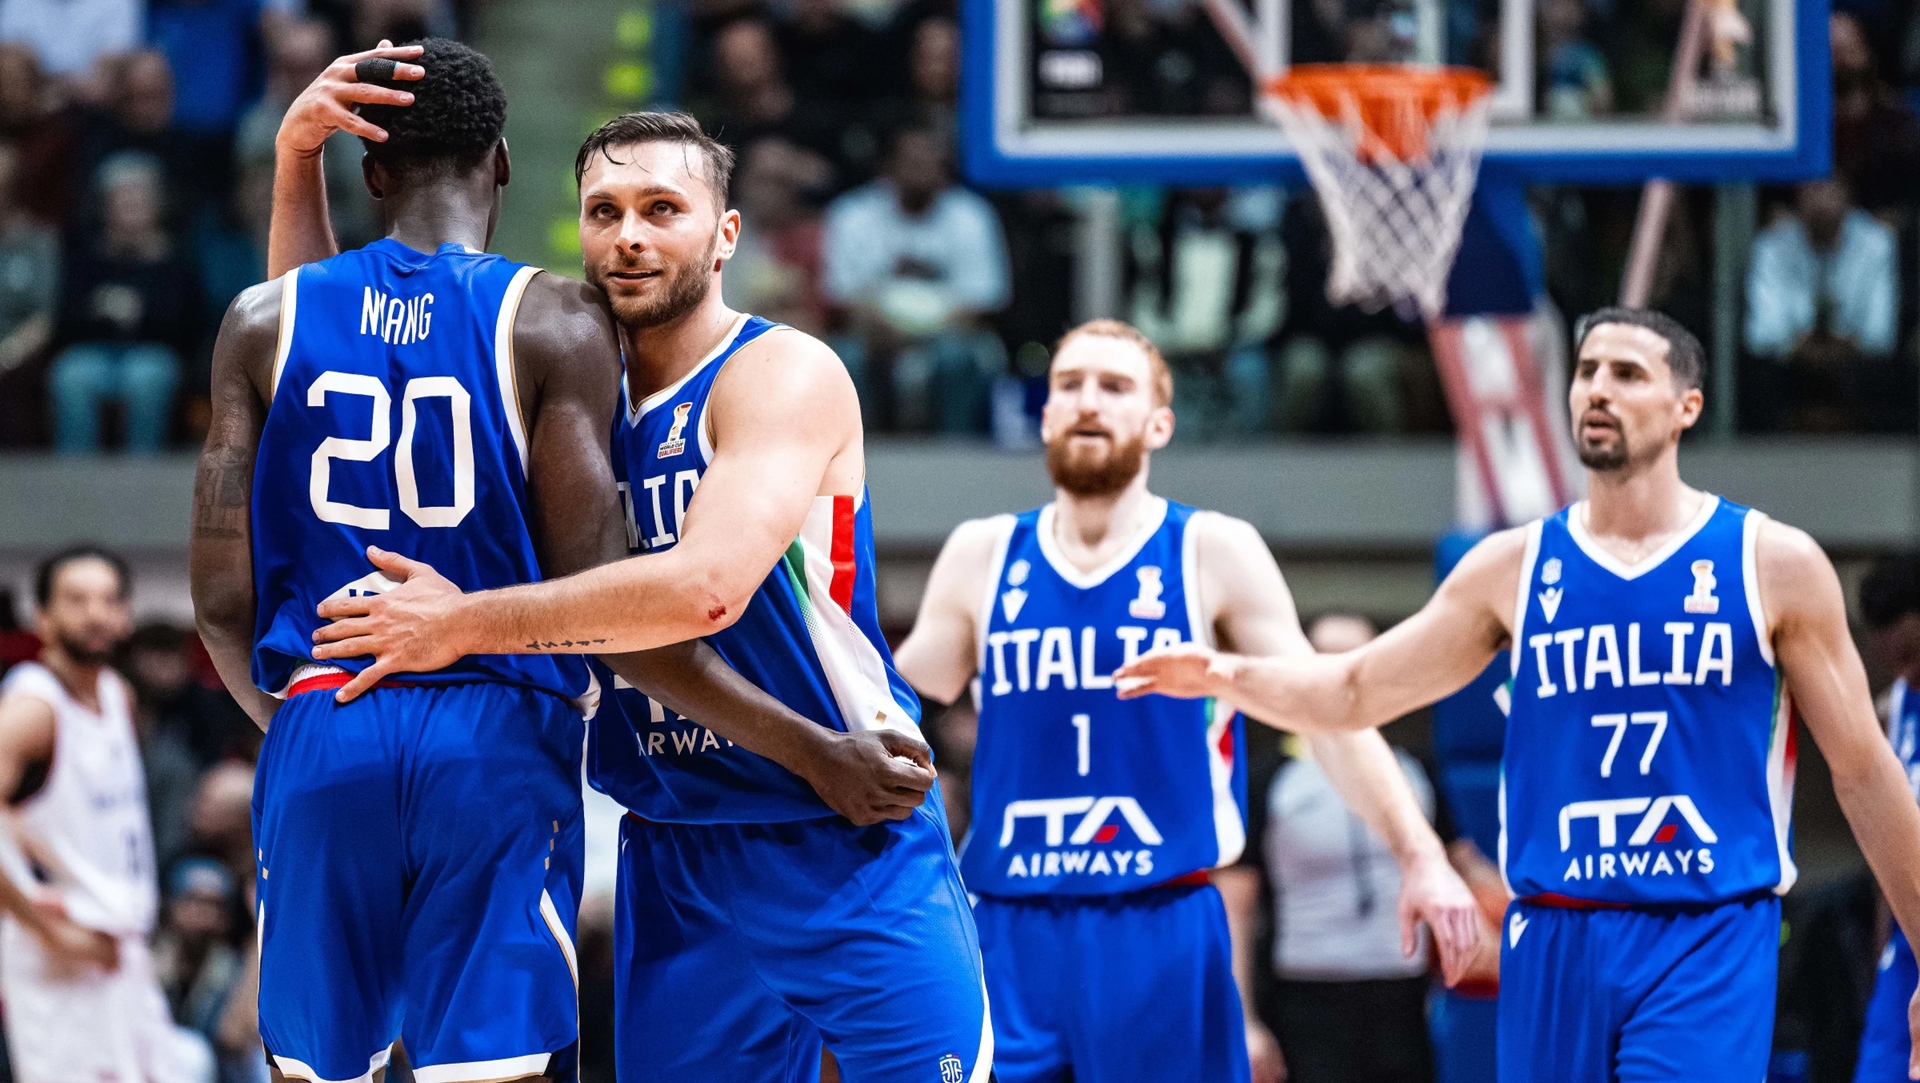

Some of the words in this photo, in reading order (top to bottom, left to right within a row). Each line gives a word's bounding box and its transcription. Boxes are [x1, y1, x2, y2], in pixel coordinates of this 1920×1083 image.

[360, 286, 434, 345] NIANG
[307, 371, 475, 530] 20
[1529, 622, 1733, 698] ITALIA
[1072, 714, 1090, 776] 1
[1591, 711, 1668, 778] 77
[999, 796, 1164, 848] ITA
[1559, 795, 1718, 852] ITA
[1007, 850, 1154, 877] AIRWAYS
[1564, 848, 1715, 881] AIRWAYS
